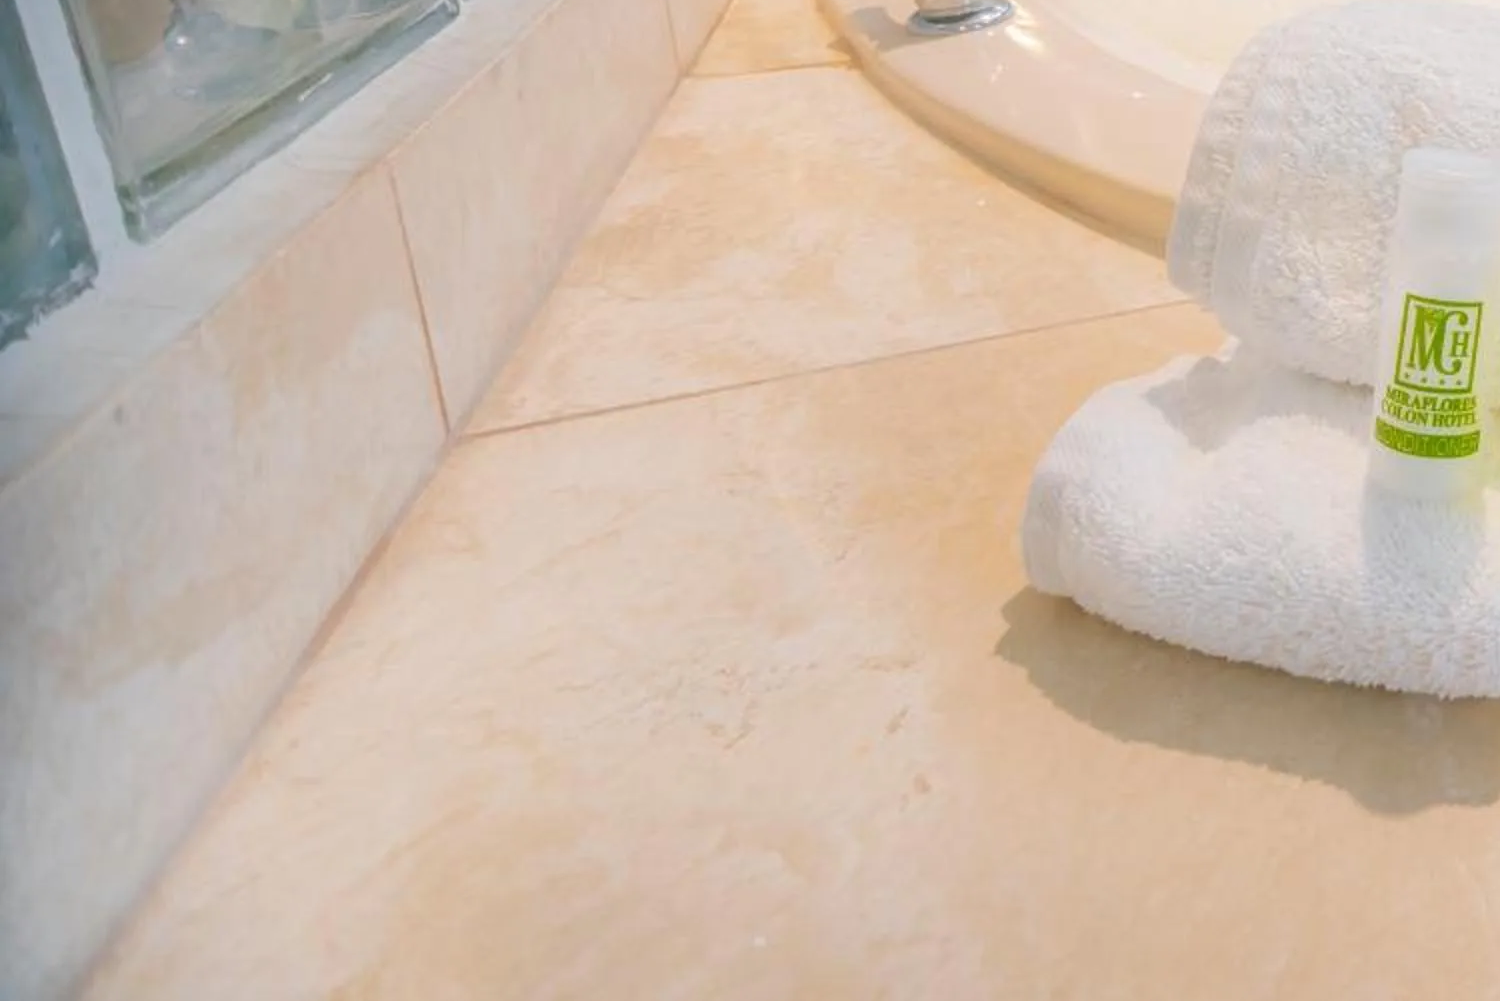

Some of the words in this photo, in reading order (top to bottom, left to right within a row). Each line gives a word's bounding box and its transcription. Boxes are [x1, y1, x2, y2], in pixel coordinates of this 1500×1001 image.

[1386, 385, 1477, 411] MIRAFLORES
[1381, 397, 1428, 427] COLON
[1432, 410, 1476, 428] HOTEL
